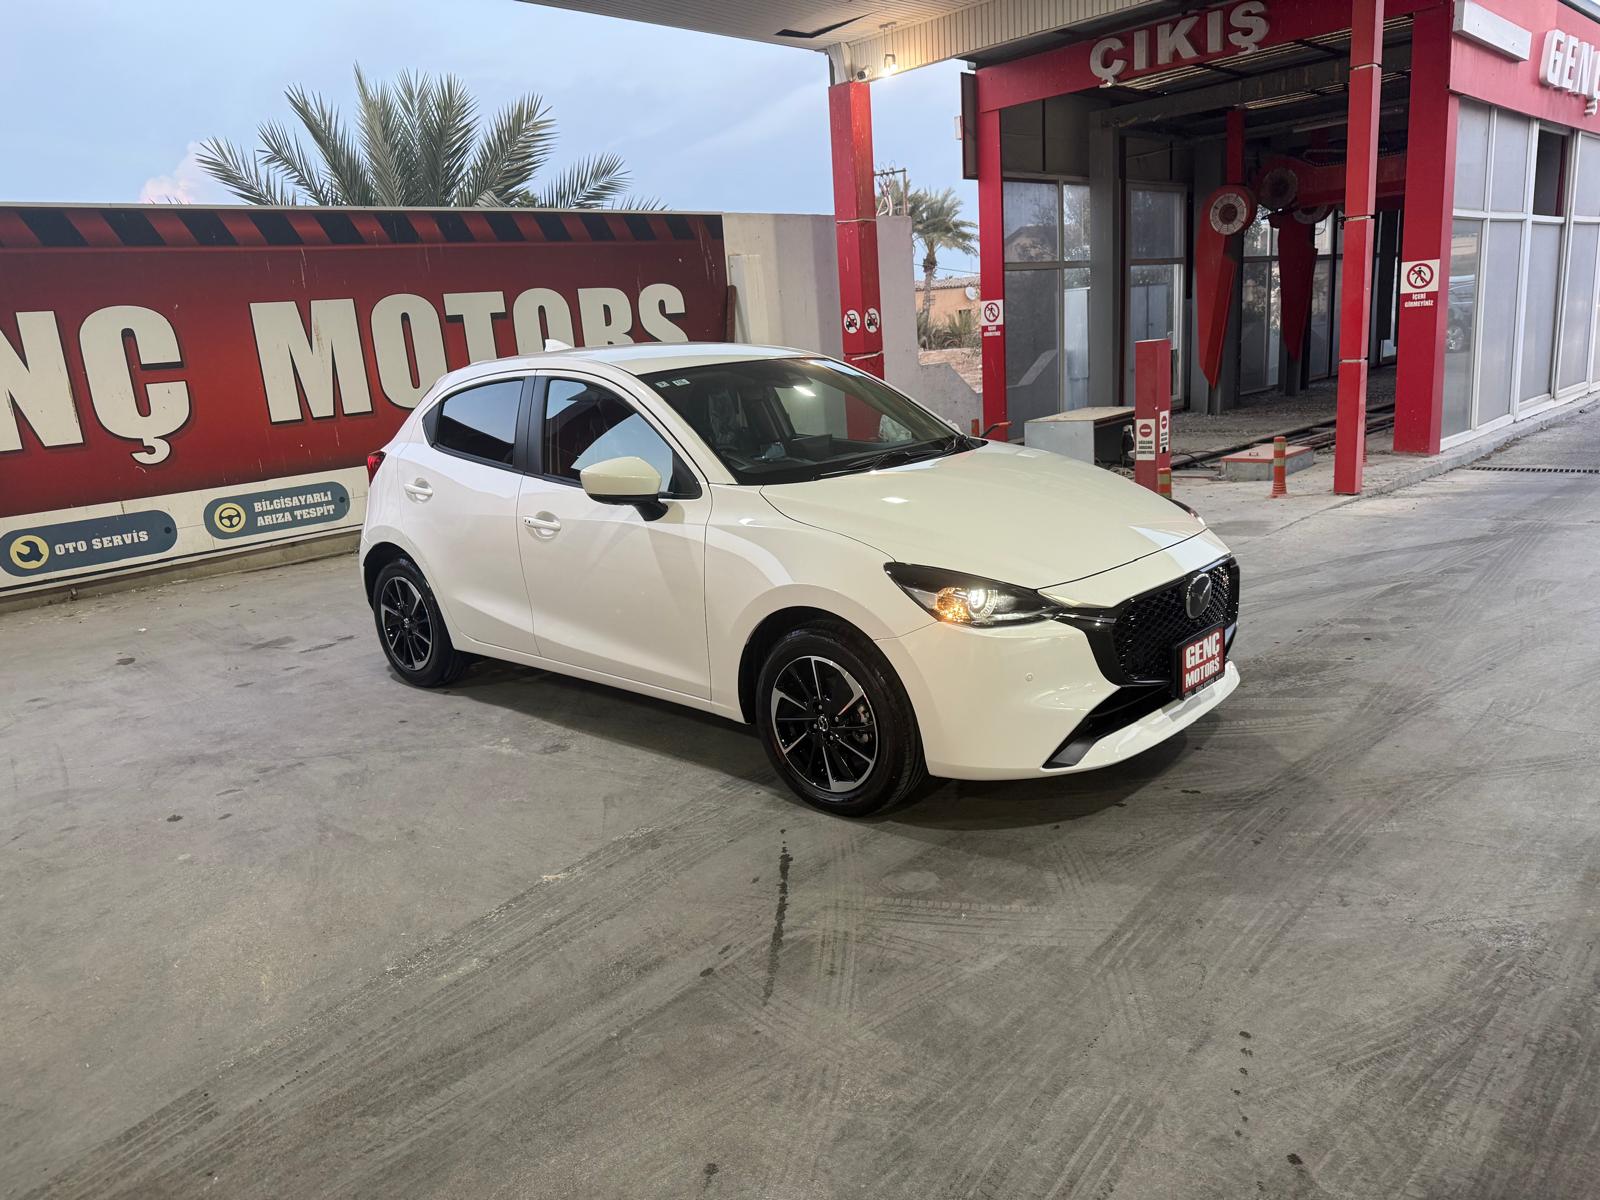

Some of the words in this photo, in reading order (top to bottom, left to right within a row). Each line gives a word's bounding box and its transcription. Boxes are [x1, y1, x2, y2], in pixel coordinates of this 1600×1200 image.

[1089, 0, 1270, 89] ÇIKIŞ
[249, 283, 689, 423] MOTORS
[254, 491, 332, 513] BİLGİSAYARLI
[256, 511, 292, 527] ARIZA
[294, 504, 335, 520] TESPİT
[54, 541, 88, 556] OTO
[92, 530, 149, 550] SERVİS
[1185, 632, 1220, 669] GENÇ
[1185, 657, 1220, 689] MOTORS
